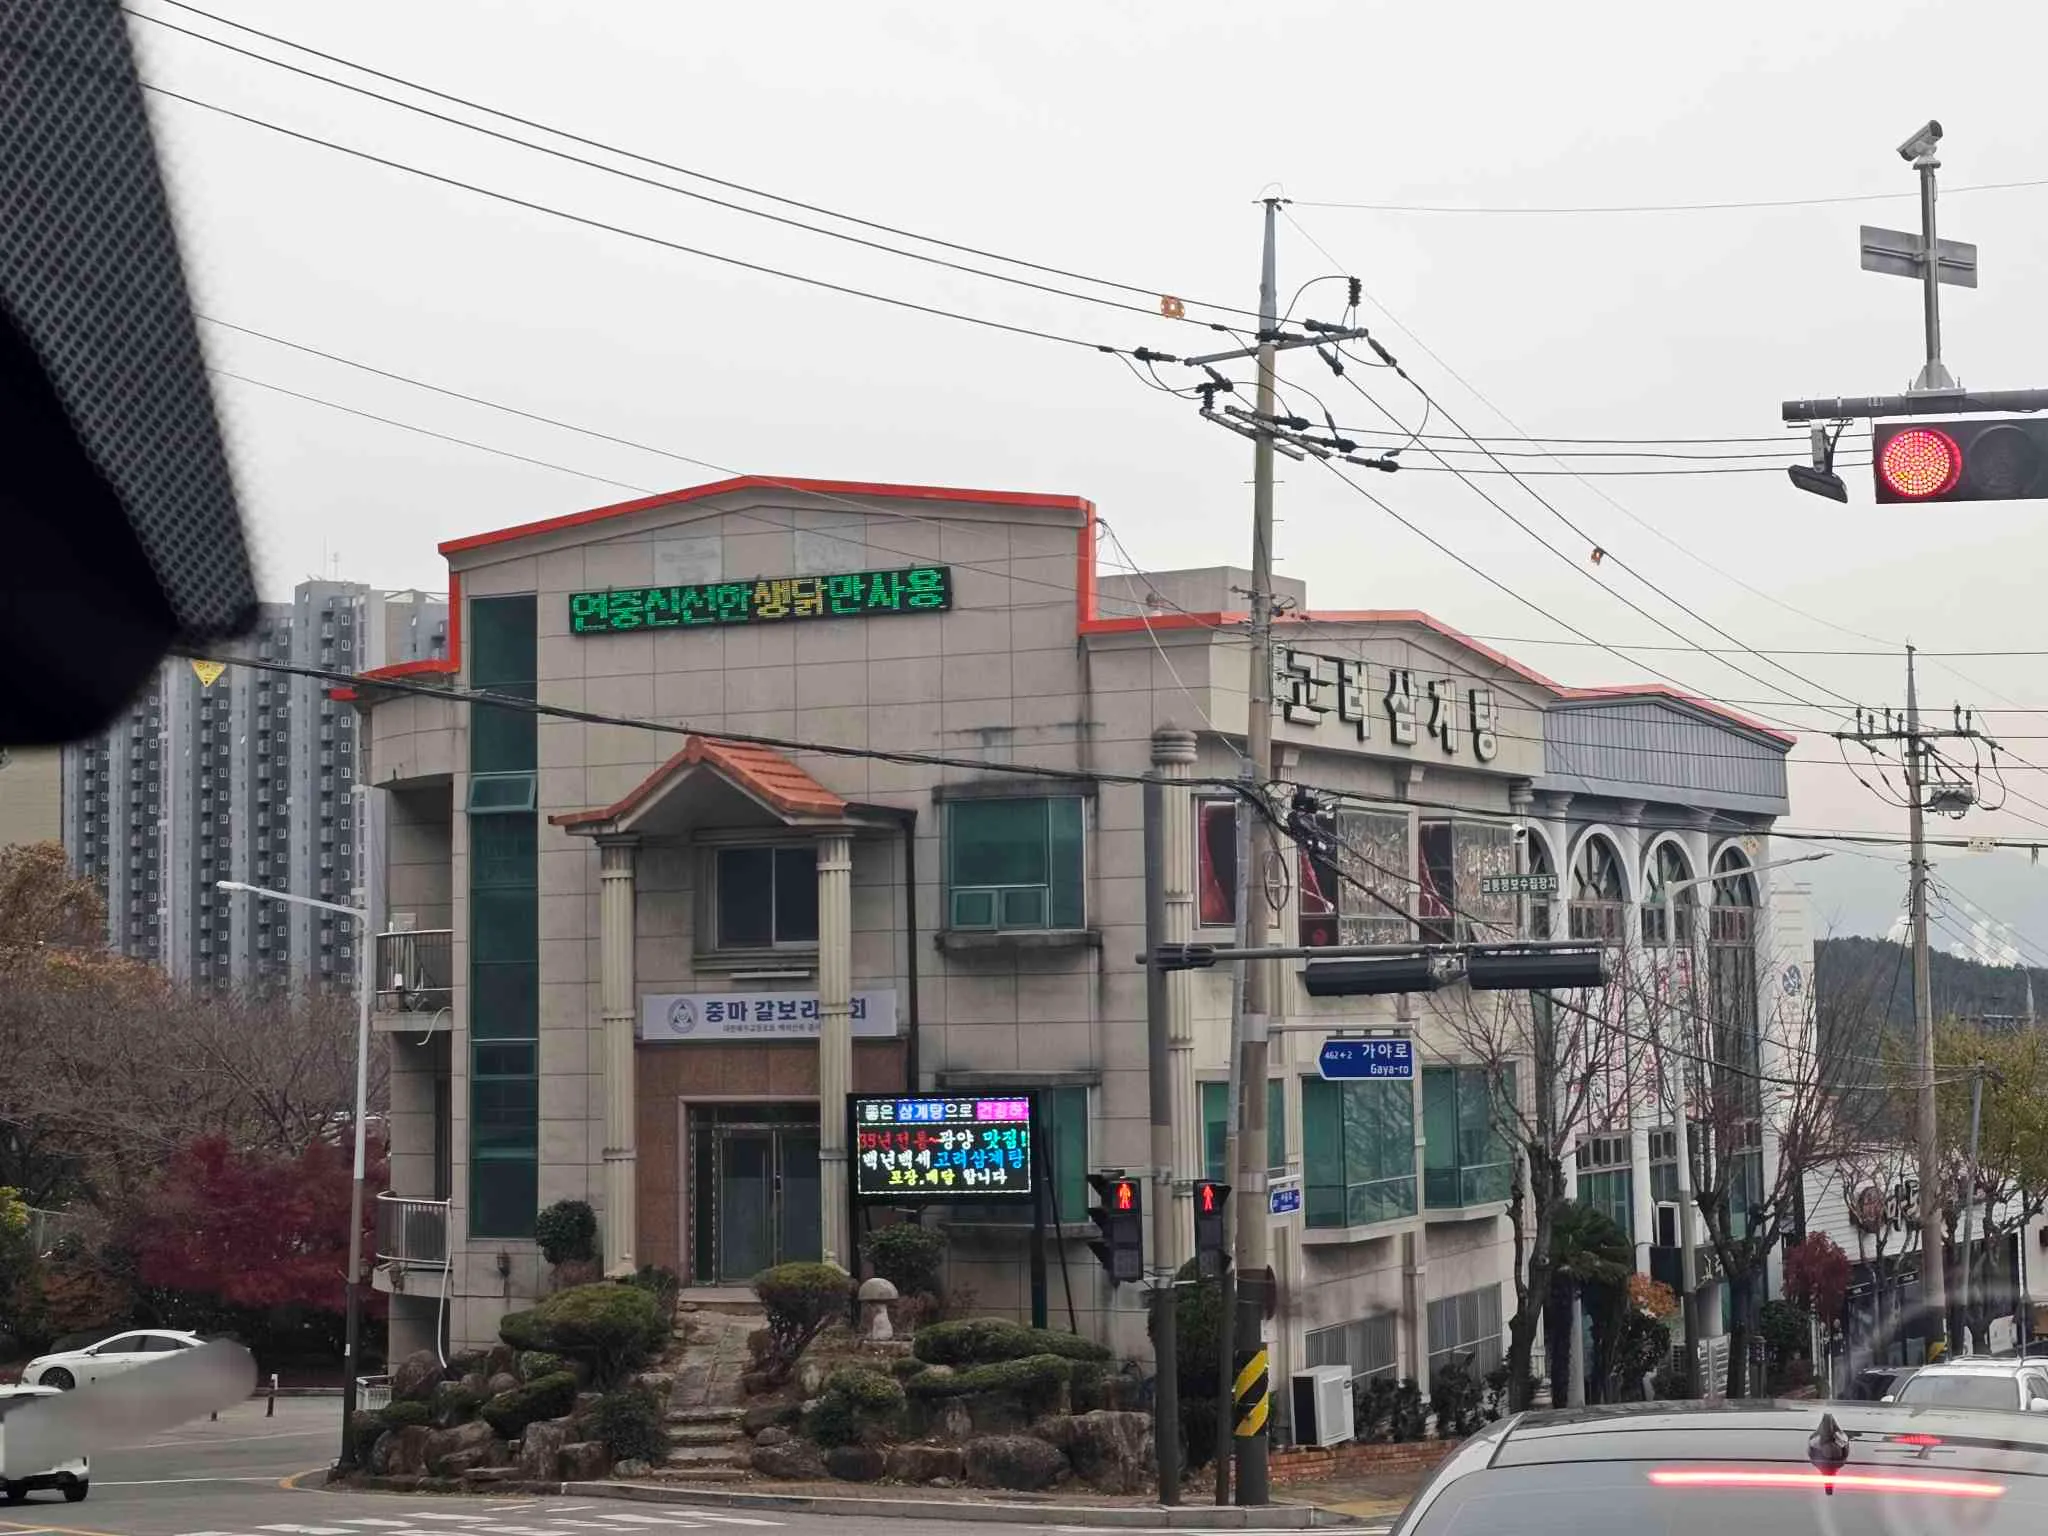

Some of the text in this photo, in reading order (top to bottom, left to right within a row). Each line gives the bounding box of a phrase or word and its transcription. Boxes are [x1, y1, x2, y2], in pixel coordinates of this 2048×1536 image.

[705, 998, 867, 1023] 중마 갈보리회
[1361, 1043, 1409, 1059] 가야로
[1370, 1063, 1409, 1076] Gaya-ro
[982, 1128, 1027, 1150] 맛집!
[963, 1168, 1008, 1185] 합니다
